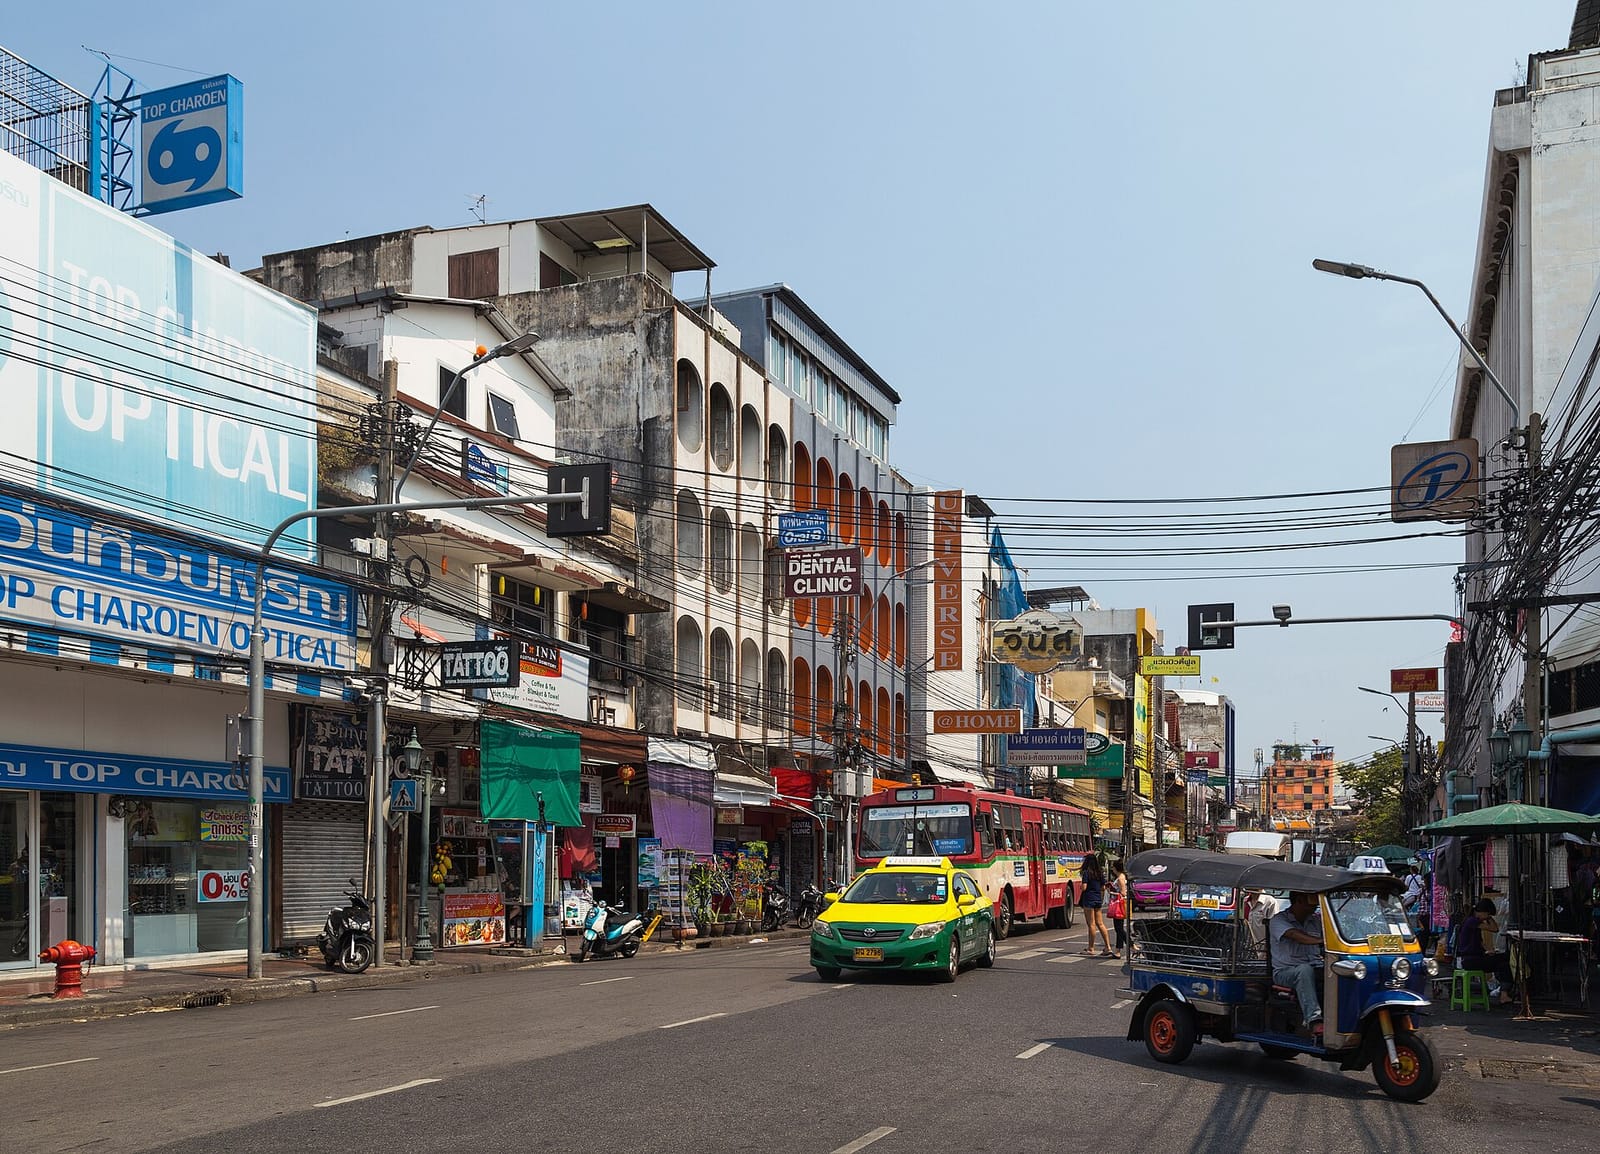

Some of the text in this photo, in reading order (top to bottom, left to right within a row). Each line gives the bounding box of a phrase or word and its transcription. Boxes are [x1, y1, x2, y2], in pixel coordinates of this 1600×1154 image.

[143, 89, 226, 119] TOP CHAROEN
[63, 261, 304, 410] TOP CHAROEN
[61, 358, 307, 502] OPTICAL
[784, 529, 822, 543] Oral-B
[788, 556, 857, 576] DENTAL
[793, 576, 852, 594] CLINIC
[939, 494, 959, 667] UNIVERSE
[51, 585, 219, 647] CHAROEN
[1003, 625, 1074, 651] วีนัส
[536, 645, 557, 660] INN
[443, 651, 509, 677] TATTOO
[530, 679, 545, 688] Coffee
[548, 692, 560, 700] Towel
[937, 714, 1017, 729] @HOME
[1031, 731, 1058, 744] แอนด์
[44, 759, 281, 793] TOP CHARON
[303, 781, 363, 796] TATTOO
[911, 790, 918, 800] 3
[211, 821, 244, 838] ถูกชัวร์
[791, 821, 811, 829] DENTAL
[1364, 858, 1383, 868] TAXI
[224, 872, 239, 883] ผ่อน
